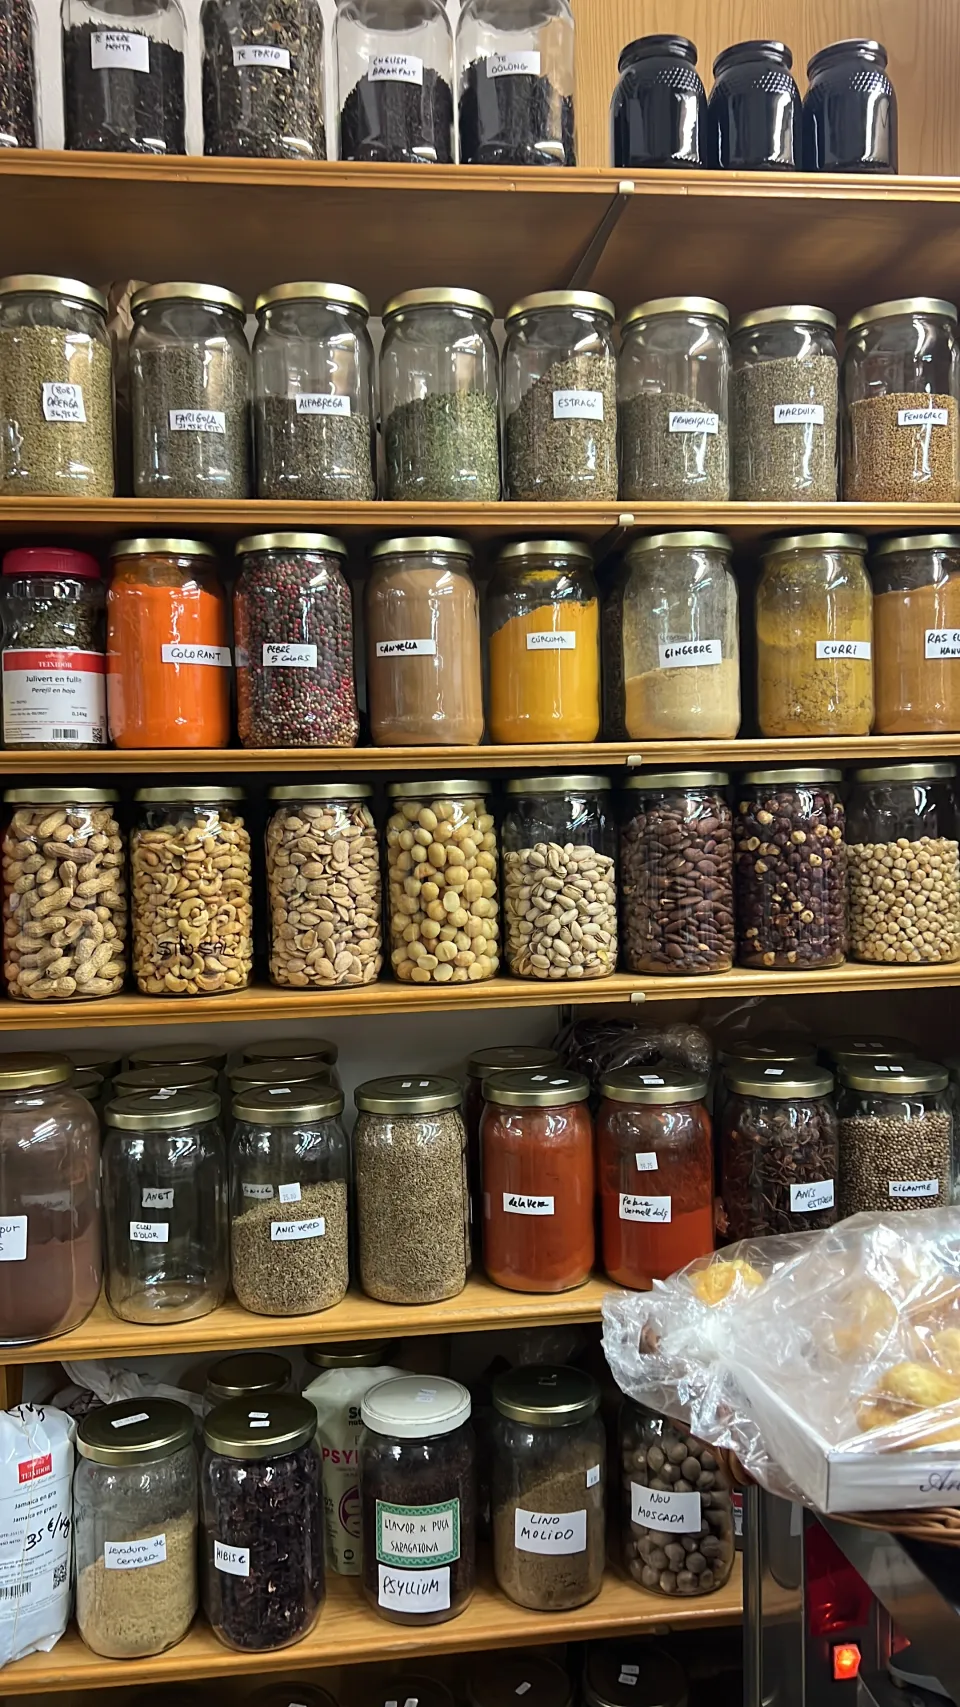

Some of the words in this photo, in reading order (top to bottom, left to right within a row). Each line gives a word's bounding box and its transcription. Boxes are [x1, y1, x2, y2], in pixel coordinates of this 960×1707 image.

[252, 49, 280, 60] TOKIO
[373, 56, 407, 65] ENGLISH
[491, 63, 528, 74] OOLONG
[175, 413, 217, 425] FARIGOLA
[927, 633, 948, 644] RAS
[379, 641, 418, 653] CANYELLA
[664, 644, 713, 659] GINGEBRE
[170, 647, 222, 662] COLORANT
[271, 655, 278, 663] 5
[38, 661, 73, 669] TEIXIDOR
[26, 675, 53, 683] Julivert
[66, 676, 82, 684] fulla
[198, 941, 236, 957] SAL
[638, 1505, 685, 1523] MOSCADA
[384, 1519, 415, 1534] LLAVOR
[432, 1518, 450, 1532] PUÇA
[25, 1527, 45, 1552] 35
[153, 1539, 165, 1547] de
